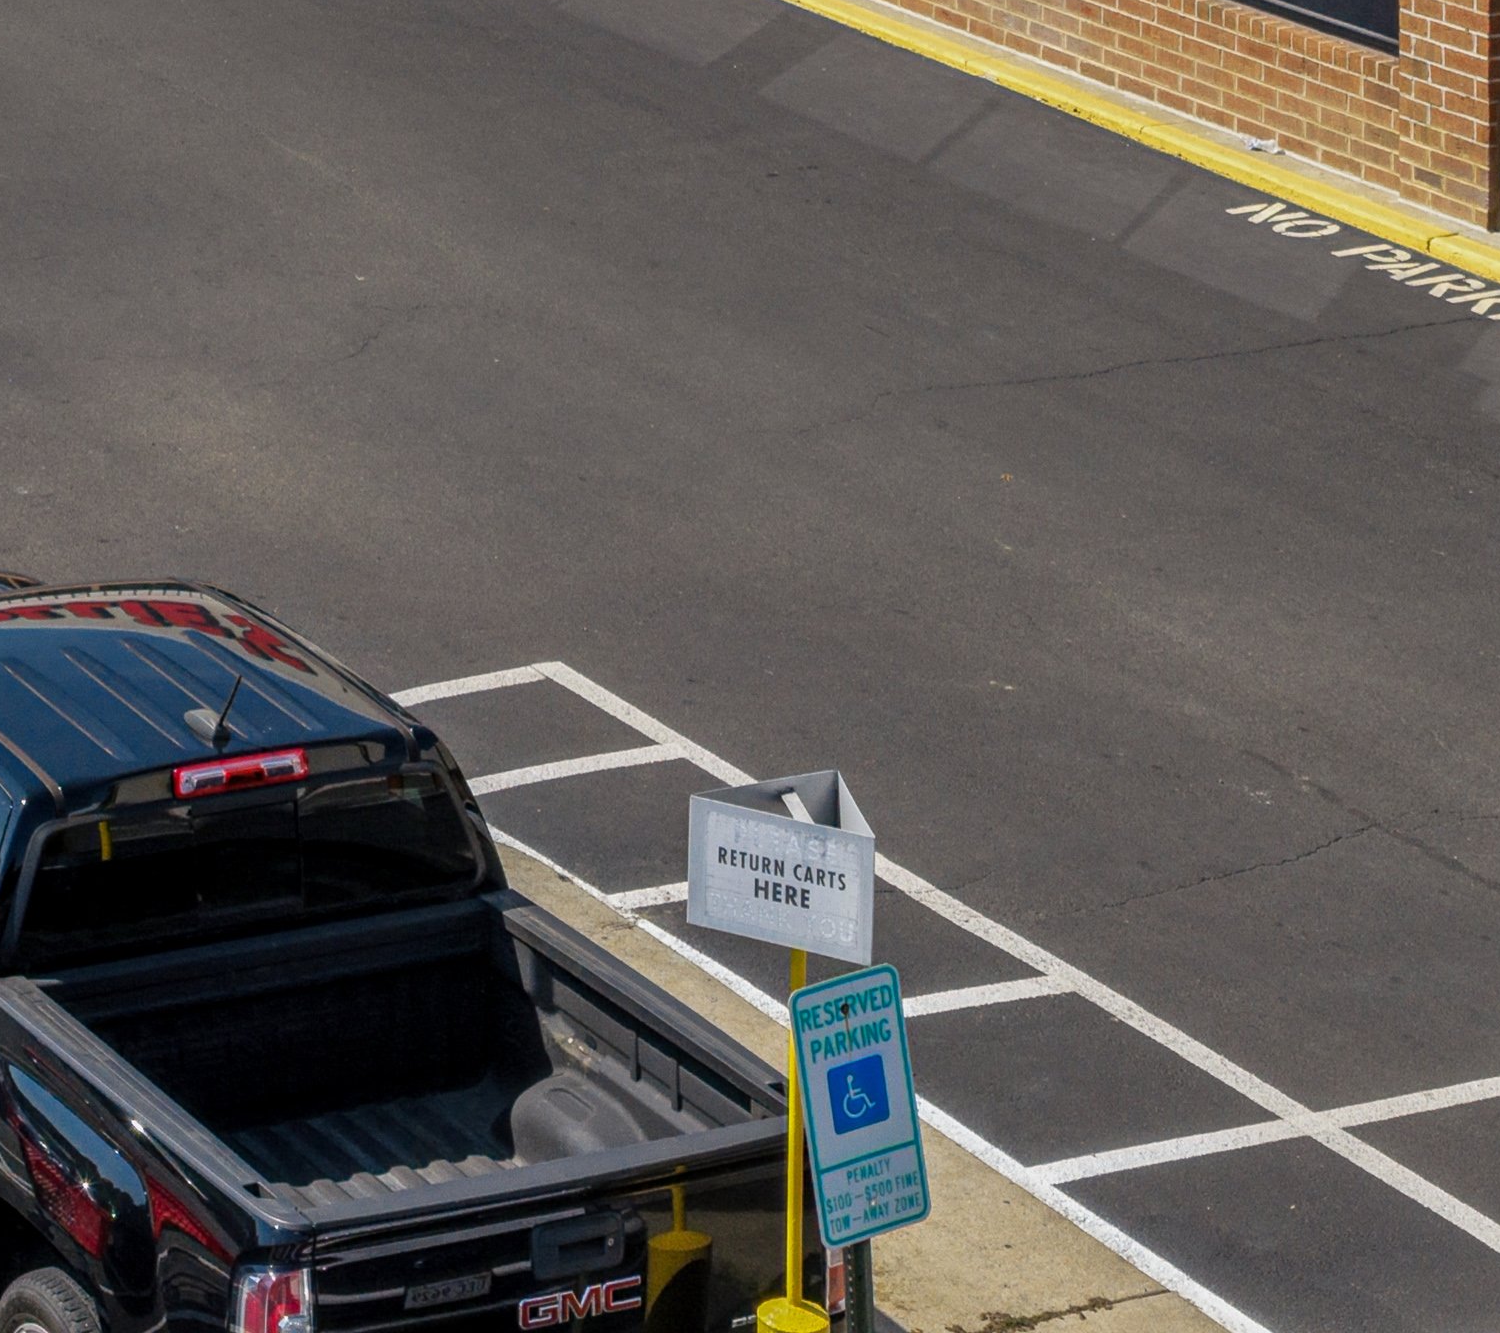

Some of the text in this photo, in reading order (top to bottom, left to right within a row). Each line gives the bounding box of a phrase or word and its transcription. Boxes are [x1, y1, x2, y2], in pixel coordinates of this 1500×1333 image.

[1226, 201, 1342, 240] NO
[718, 846, 847, 891] RETURN CARTS
[754, 878, 811, 910] HERE
[800, 984, 893, 1033] RESERVED
[810, 1018, 892, 1065] PARKING
[846, 1158, 891, 1185] PENALTY
[894, 1171, 920, 1192] FINE
[894, 1192, 921, 1214] ZONE
[518, 1275, 642, 1330] GMC
